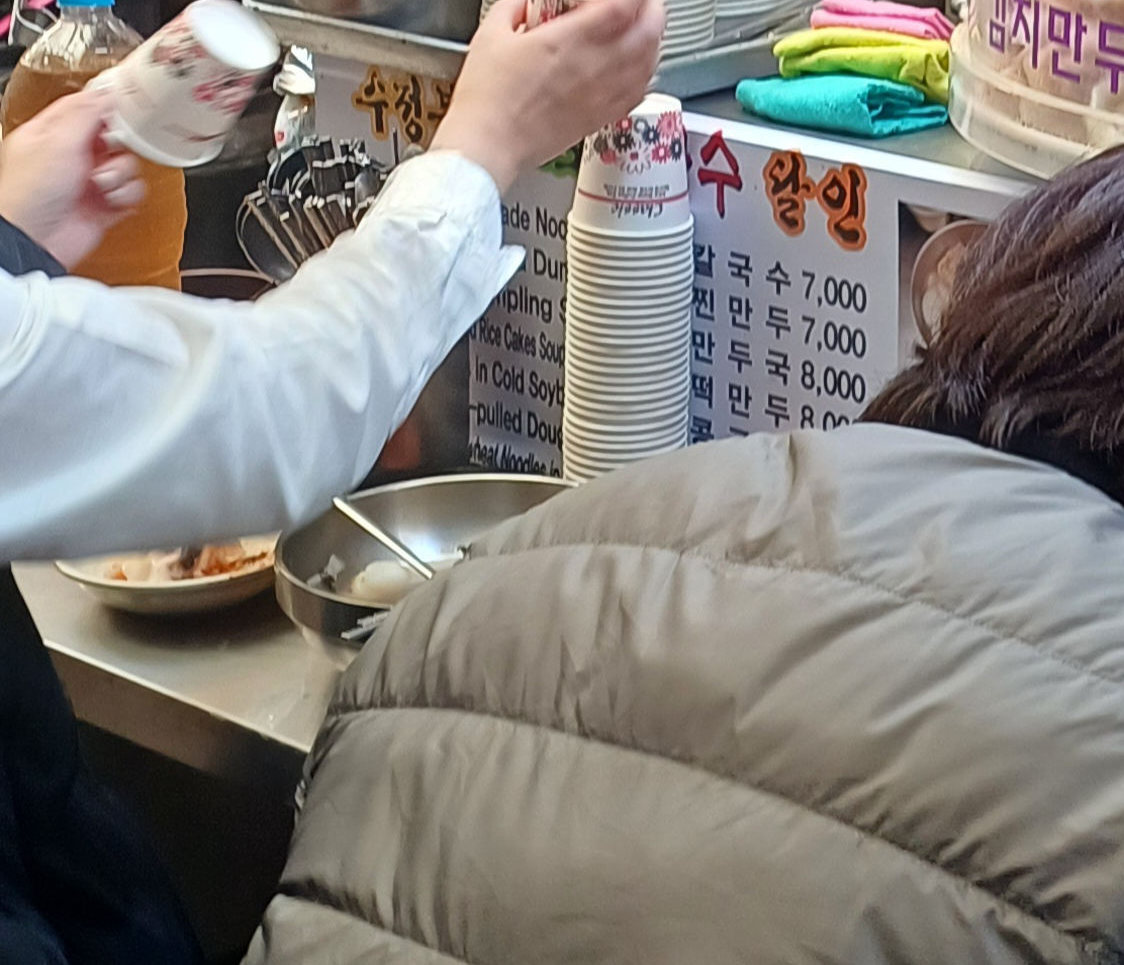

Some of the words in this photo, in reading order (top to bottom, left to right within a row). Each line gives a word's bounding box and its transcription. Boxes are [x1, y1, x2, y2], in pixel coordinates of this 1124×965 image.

[694, 130, 743, 218] 수
[801, 271, 868, 314] 7,000
[480, 317, 501, 348] Rice
[504, 322, 536, 357] Cakes
[540, 331, 565, 369] Soup
[801, 315, 868, 359] 7,000
[475, 354, 488, 384] In
[492, 360, 525, 396] Cold
[800, 360, 867, 404] 8,000
